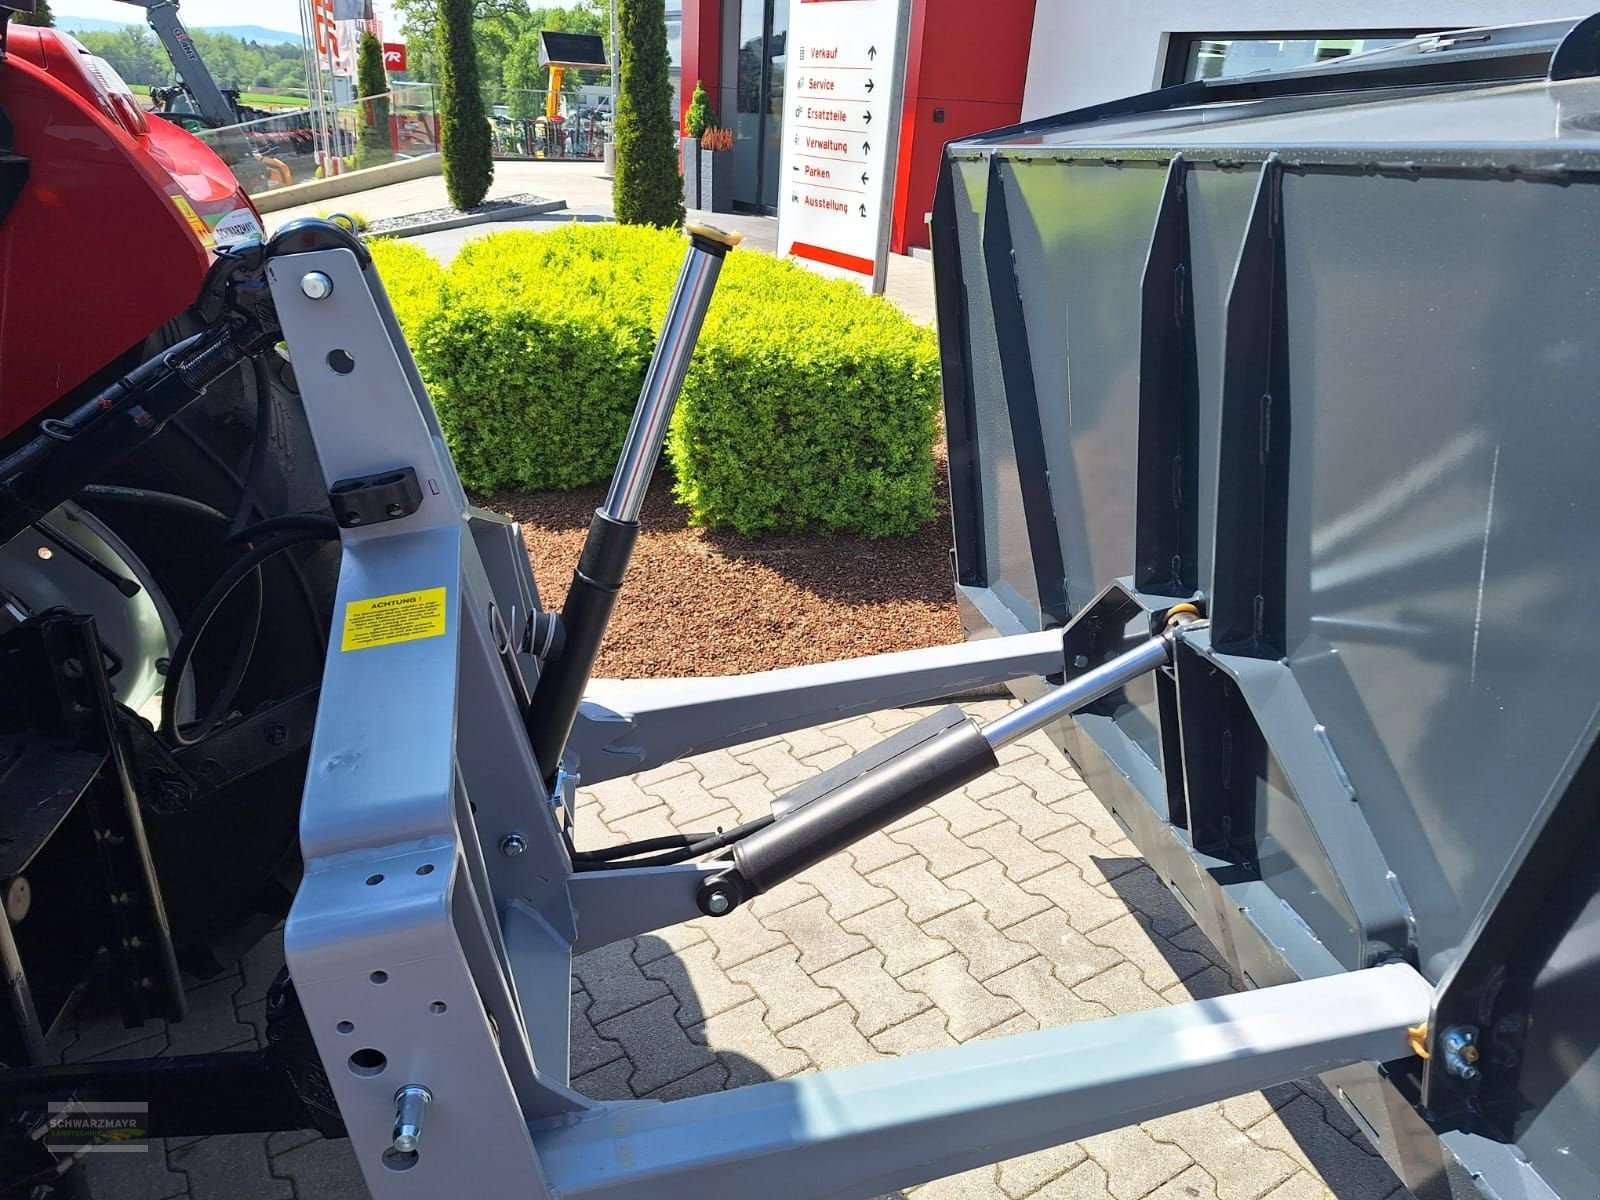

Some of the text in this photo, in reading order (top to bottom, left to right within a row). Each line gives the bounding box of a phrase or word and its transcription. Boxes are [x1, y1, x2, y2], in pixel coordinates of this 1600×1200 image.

[810, 47, 838, 59] Verkauf
[808, 78, 835, 90] Service
[807, 107, 847, 122] Ersatzteile
[806, 136, 848, 154] Verwaltung
[804, 165, 831, 179] Parken
[804, 195, 849, 214] Ausstellung
[371, 597, 417, 609] ACHTUNG
